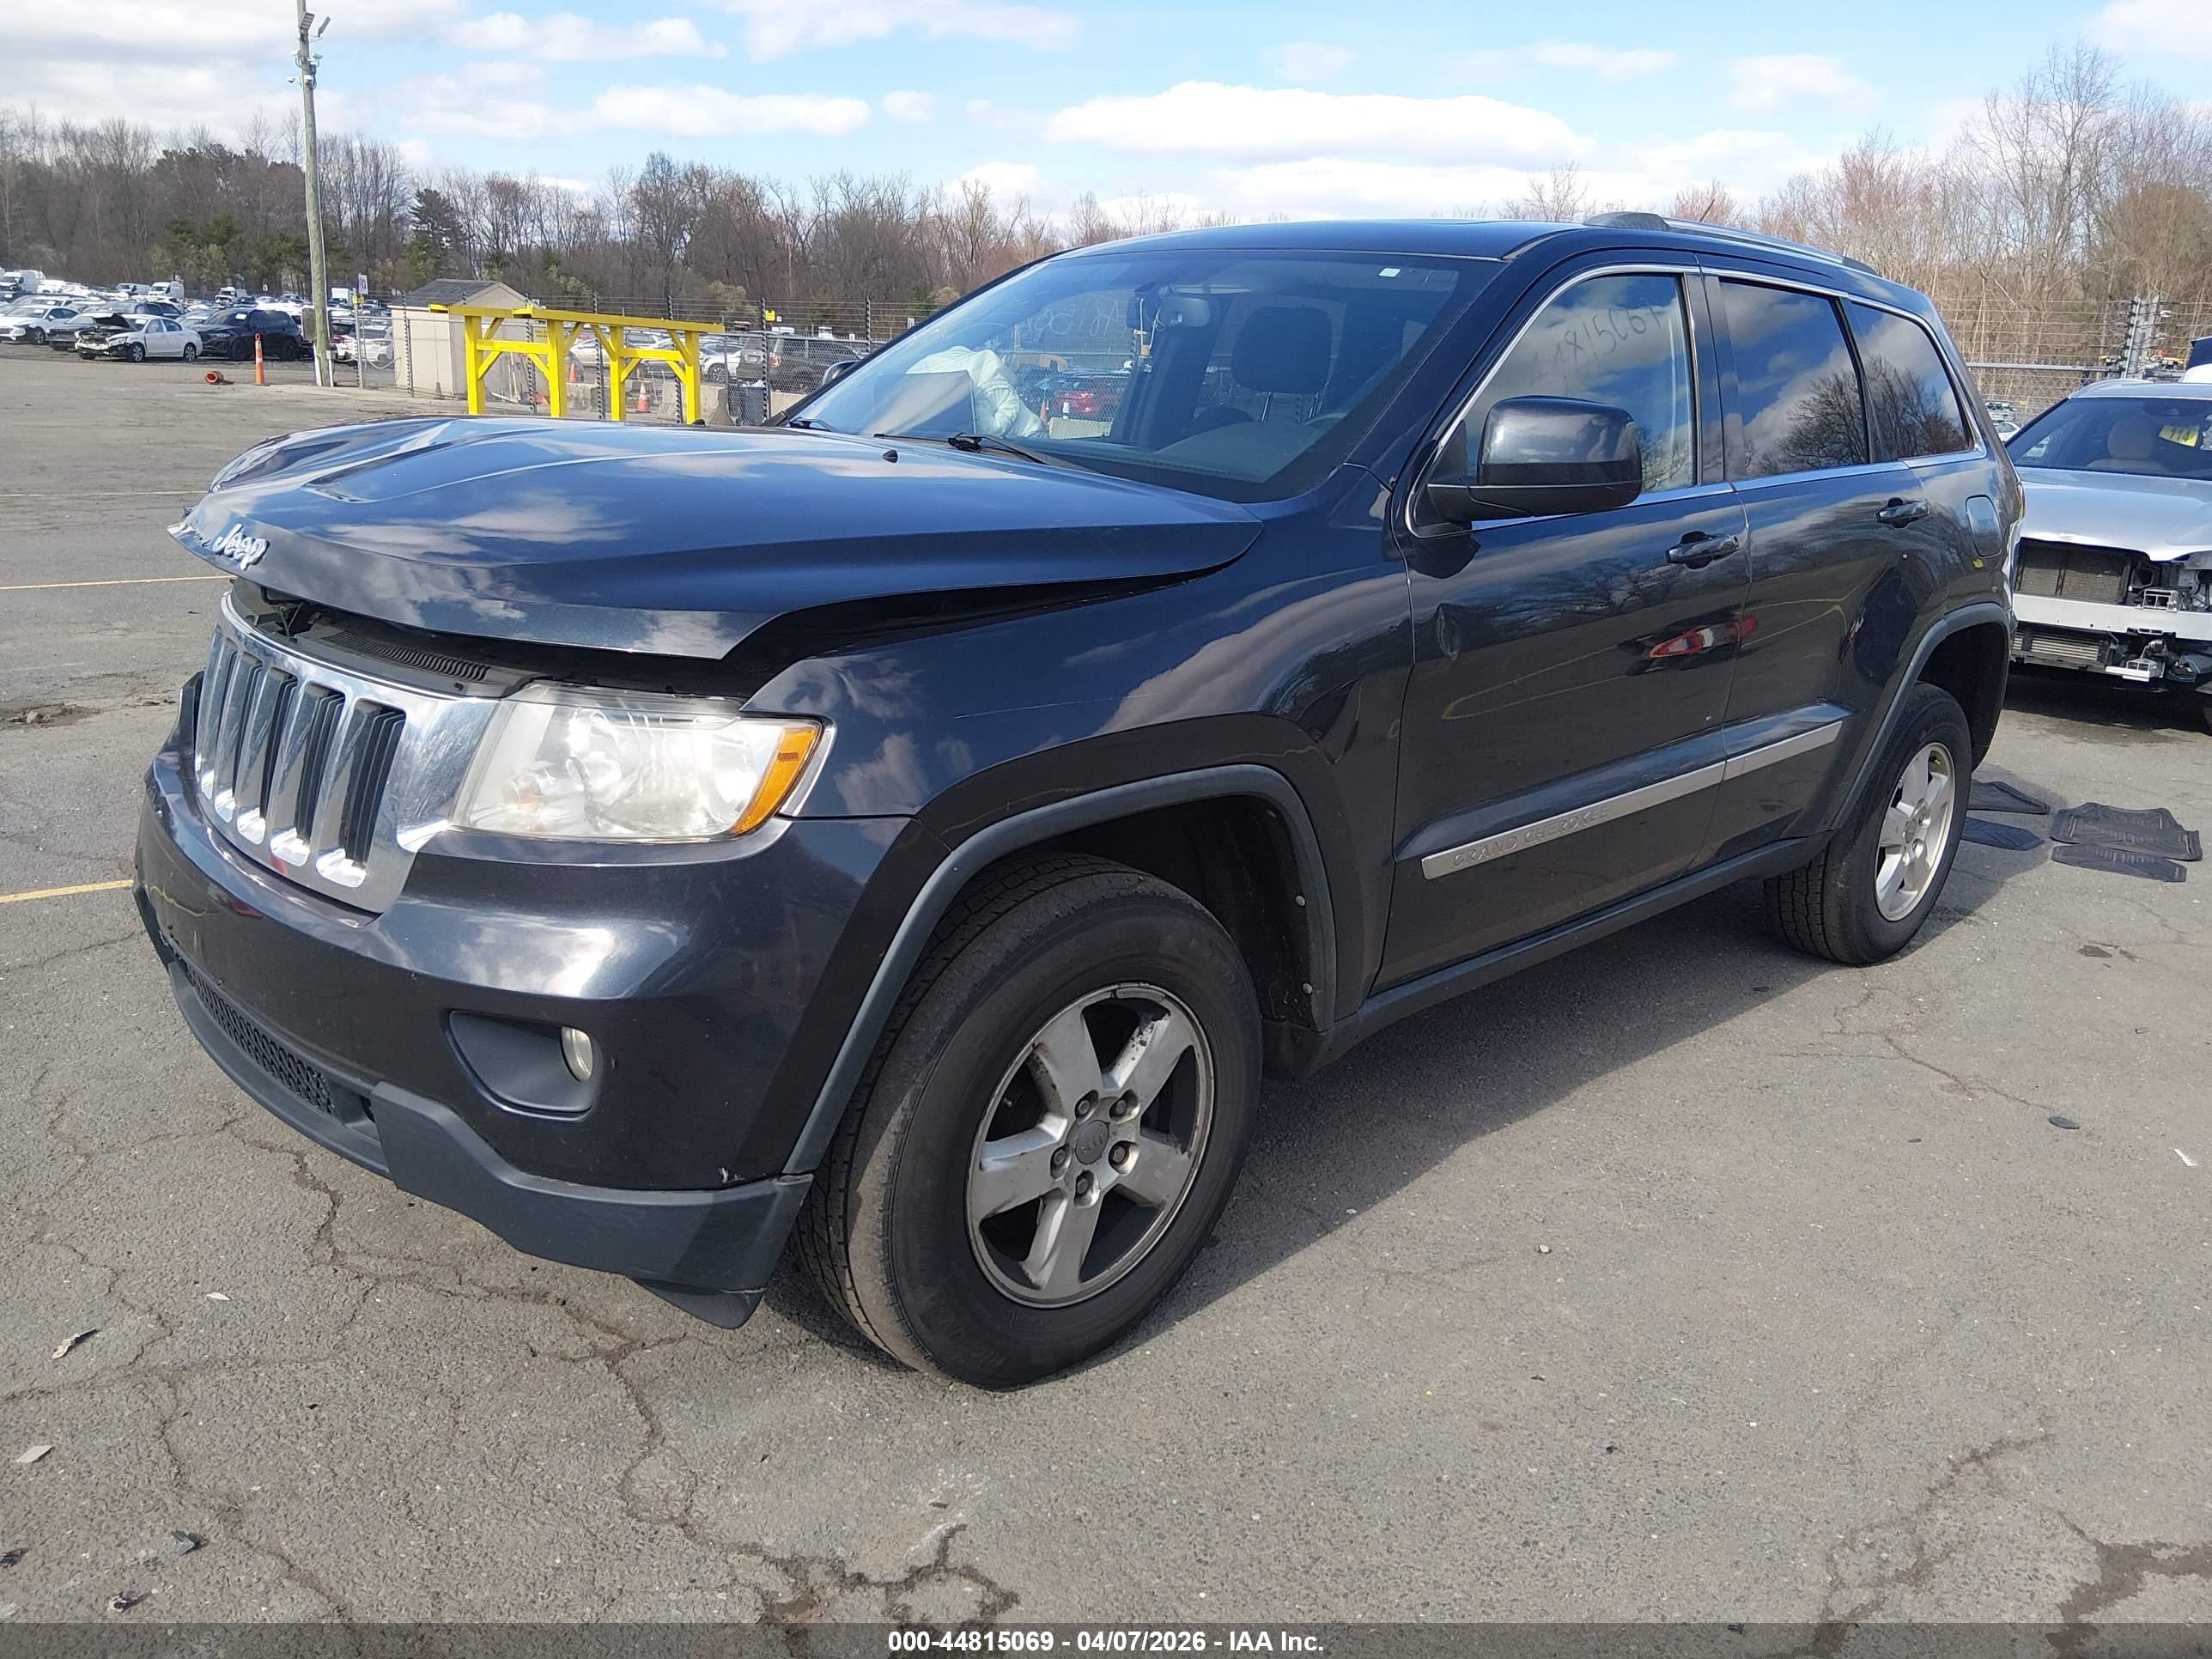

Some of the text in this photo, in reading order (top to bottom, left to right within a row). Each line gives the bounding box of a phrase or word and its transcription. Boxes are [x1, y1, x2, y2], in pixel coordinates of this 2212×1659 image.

[212, 523, 270, 571] Jeep
[1452, 805, 1611, 869] GRAND CHEROKEE
